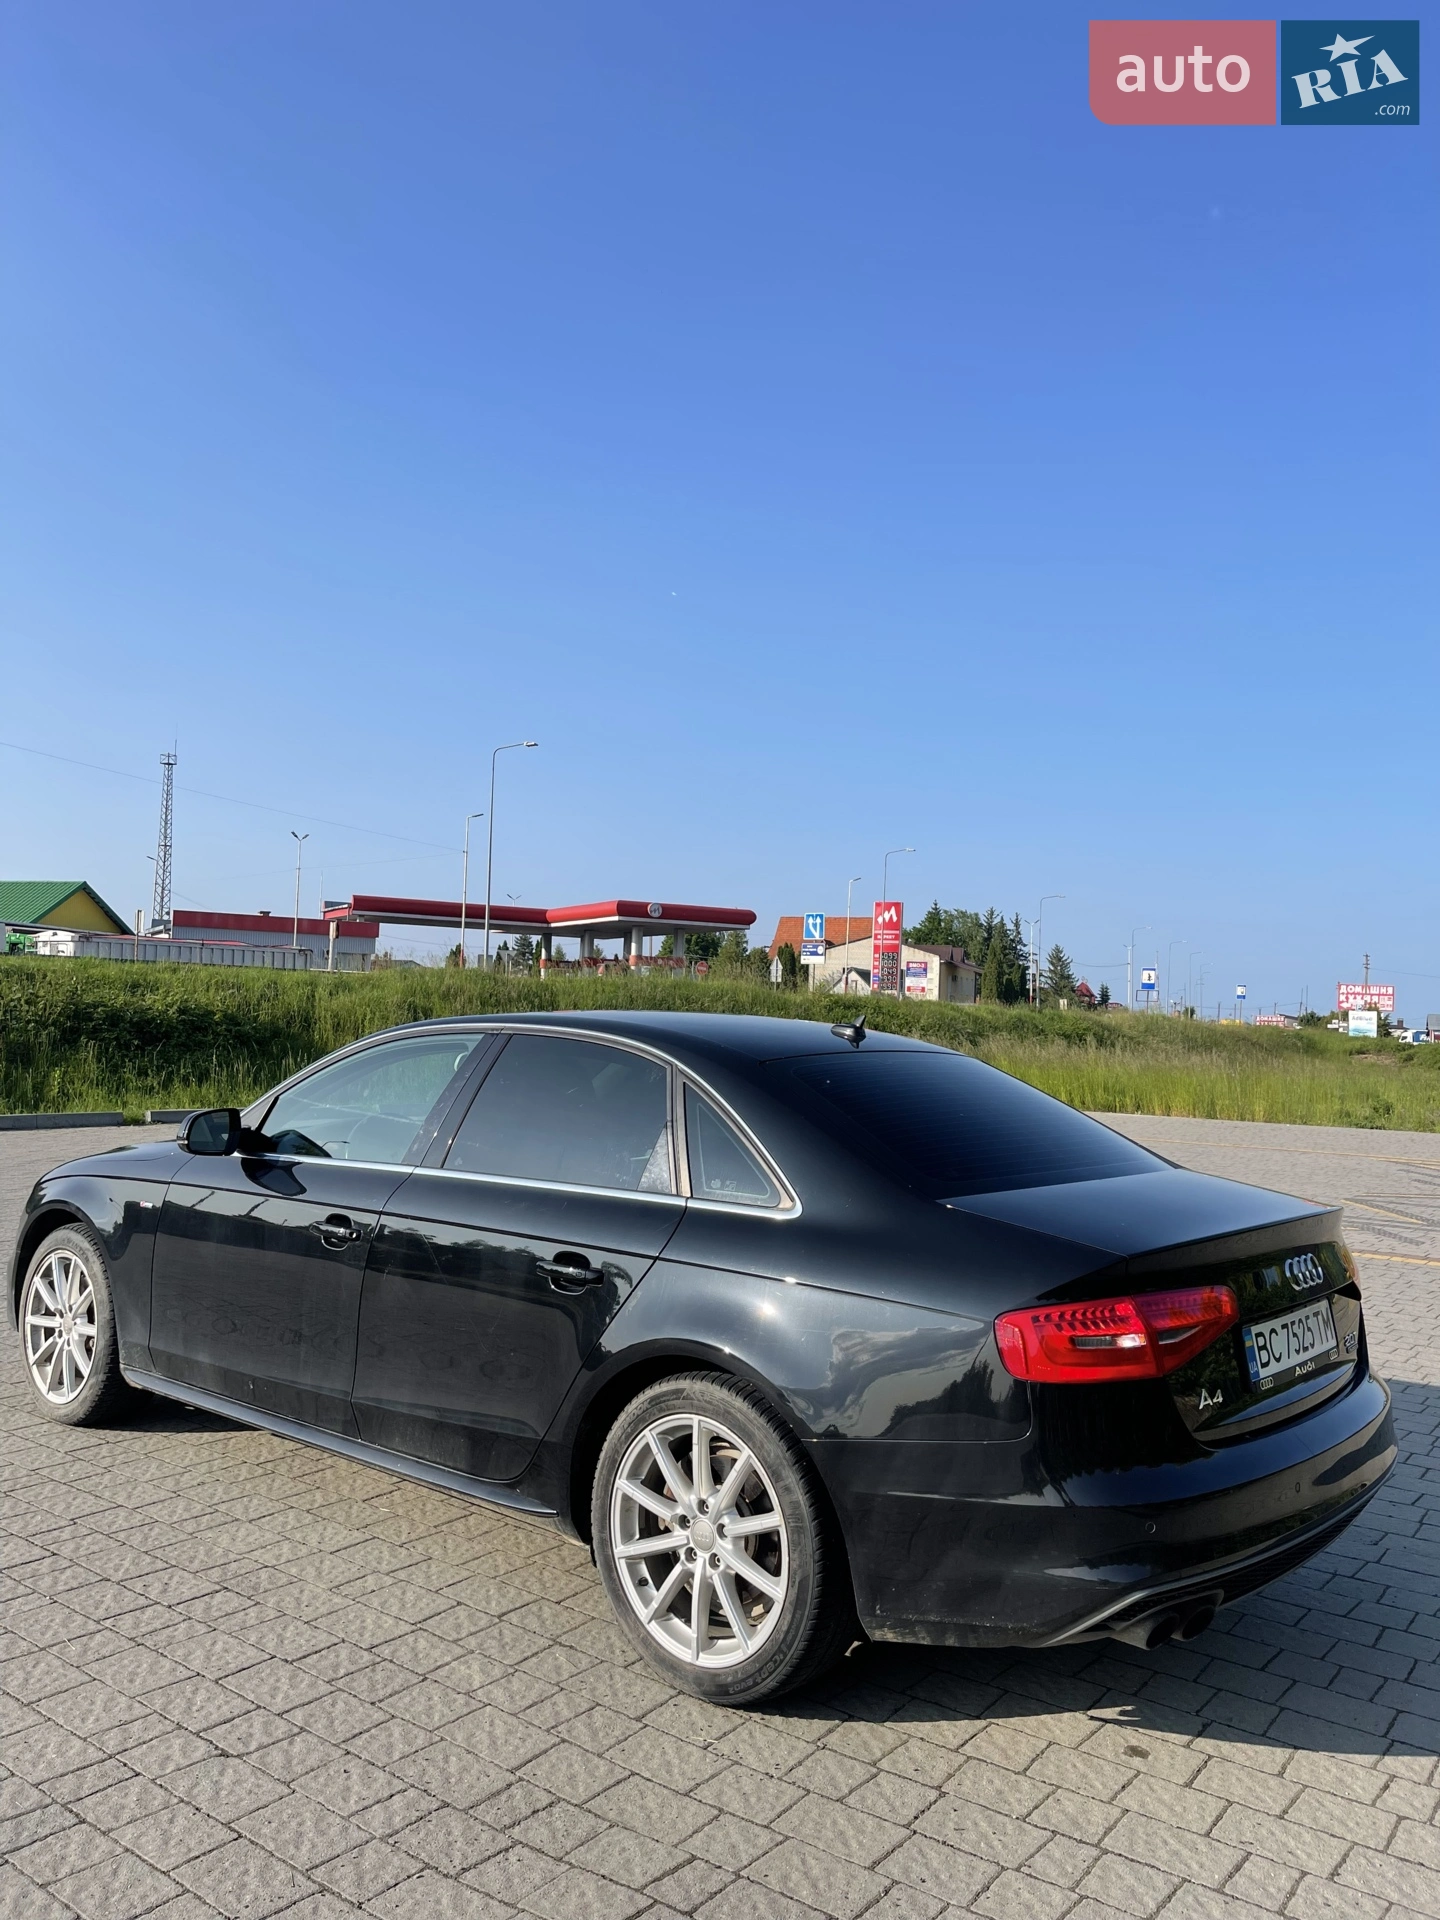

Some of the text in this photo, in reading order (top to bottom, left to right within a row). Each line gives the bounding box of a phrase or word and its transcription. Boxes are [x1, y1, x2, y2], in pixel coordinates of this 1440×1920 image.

[1339, 984, 1394, 995] ДОМАШНЯ
[1254, 1307, 1334, 1369] BC 7525 TM
[1248, 1361, 1259, 1374] UA
[1295, 1361, 1316, 1377] Audi
[1198, 1388, 1224, 1410] A4
